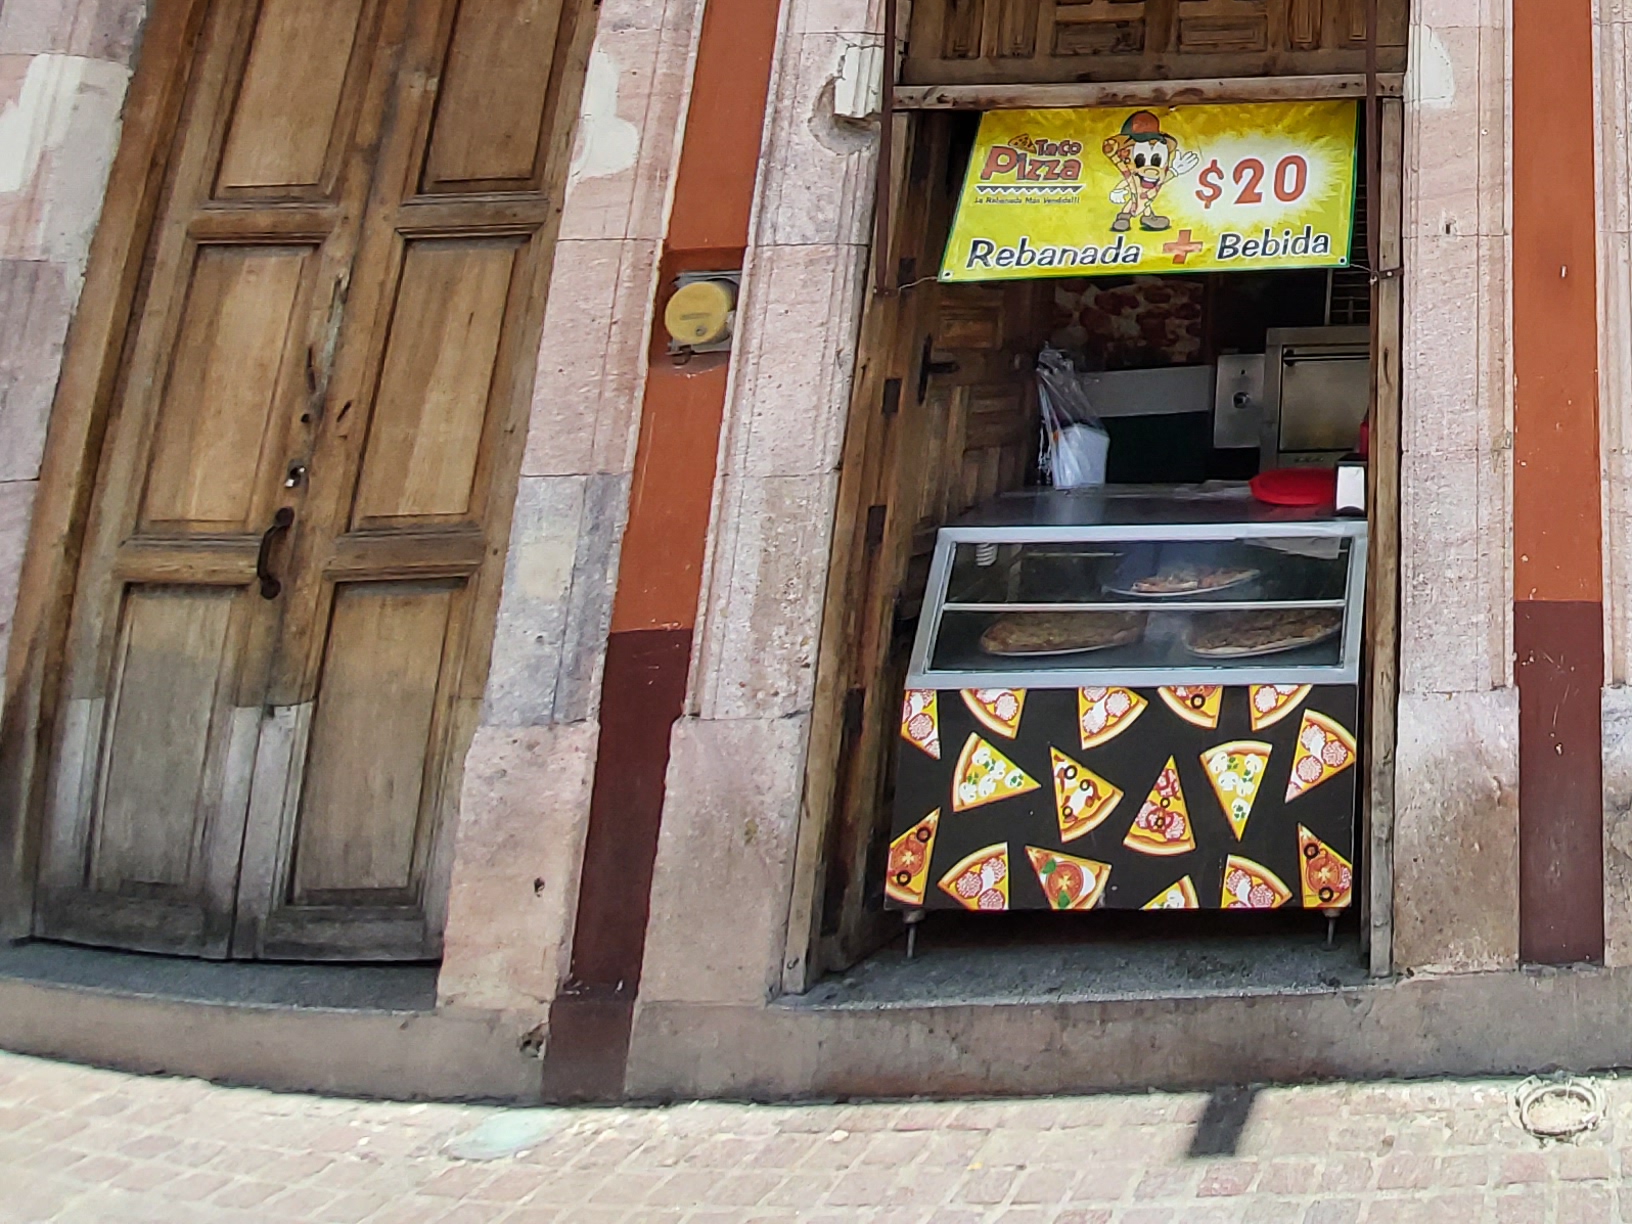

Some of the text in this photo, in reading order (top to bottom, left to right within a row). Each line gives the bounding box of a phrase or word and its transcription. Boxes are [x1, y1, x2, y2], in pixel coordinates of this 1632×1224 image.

[980, 145, 1082, 182] Pizza
[1034, 138, 1083, 157] Taco
[1195, 154, 1308, 210] $20
[966, 234, 1142, 269] Rebanada
[1216, 224, 1332, 260] Bebida
